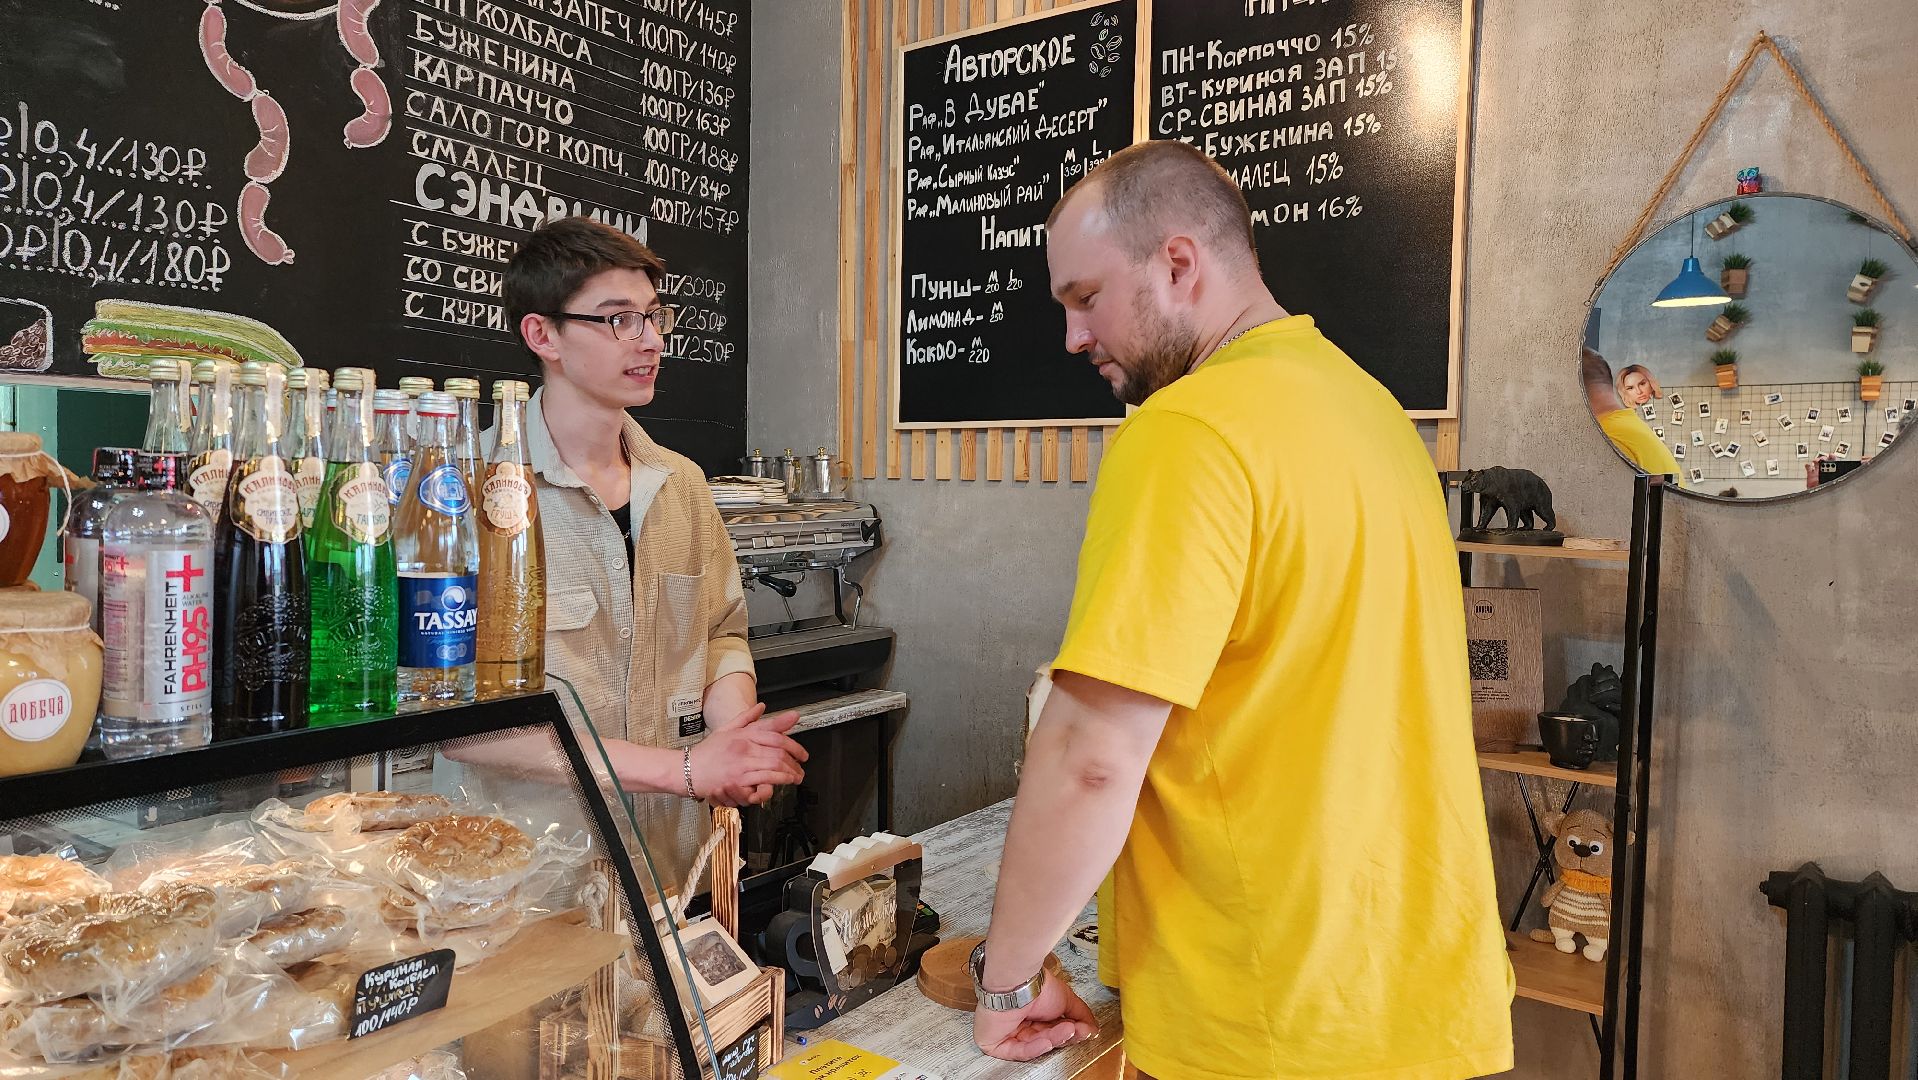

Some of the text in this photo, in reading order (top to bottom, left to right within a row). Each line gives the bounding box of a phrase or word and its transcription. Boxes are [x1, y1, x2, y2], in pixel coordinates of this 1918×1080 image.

[415, 12, 576, 93] БУЖЕНИНА
[476, 2, 593, 65] КОЛБАСА
[1330, 23, 1375, 50] 15%
[1313, 51, 1366, 82] ЗАП
[1376, 46, 1400, 71] 15
[414, 50, 574, 125] КАРПАЧЧО
[1300, 78, 1346, 112] ЗАП
[1354, 70, 1393, 98] 15%
[406, 91, 629, 177] САЛО ГОР. КОПЧ.
[1343, 112, 1382, 138] 15%
[412, 131, 547, 196] СМАЛЕЦ
[1305, 151, 1345, 186] 15%
[1250, 195, 1363, 228] МОН 16%
[411, 221, 518, 263] С БУЖЕ
[406, 256, 502, 297] СО СВИ
[405, 292, 508, 332] С КУРИ
[968, 347, 990, 363] 220
[164, 581, 177, 695] FAHRENHEIT
[414, 608, 477, 631] TASSAY
